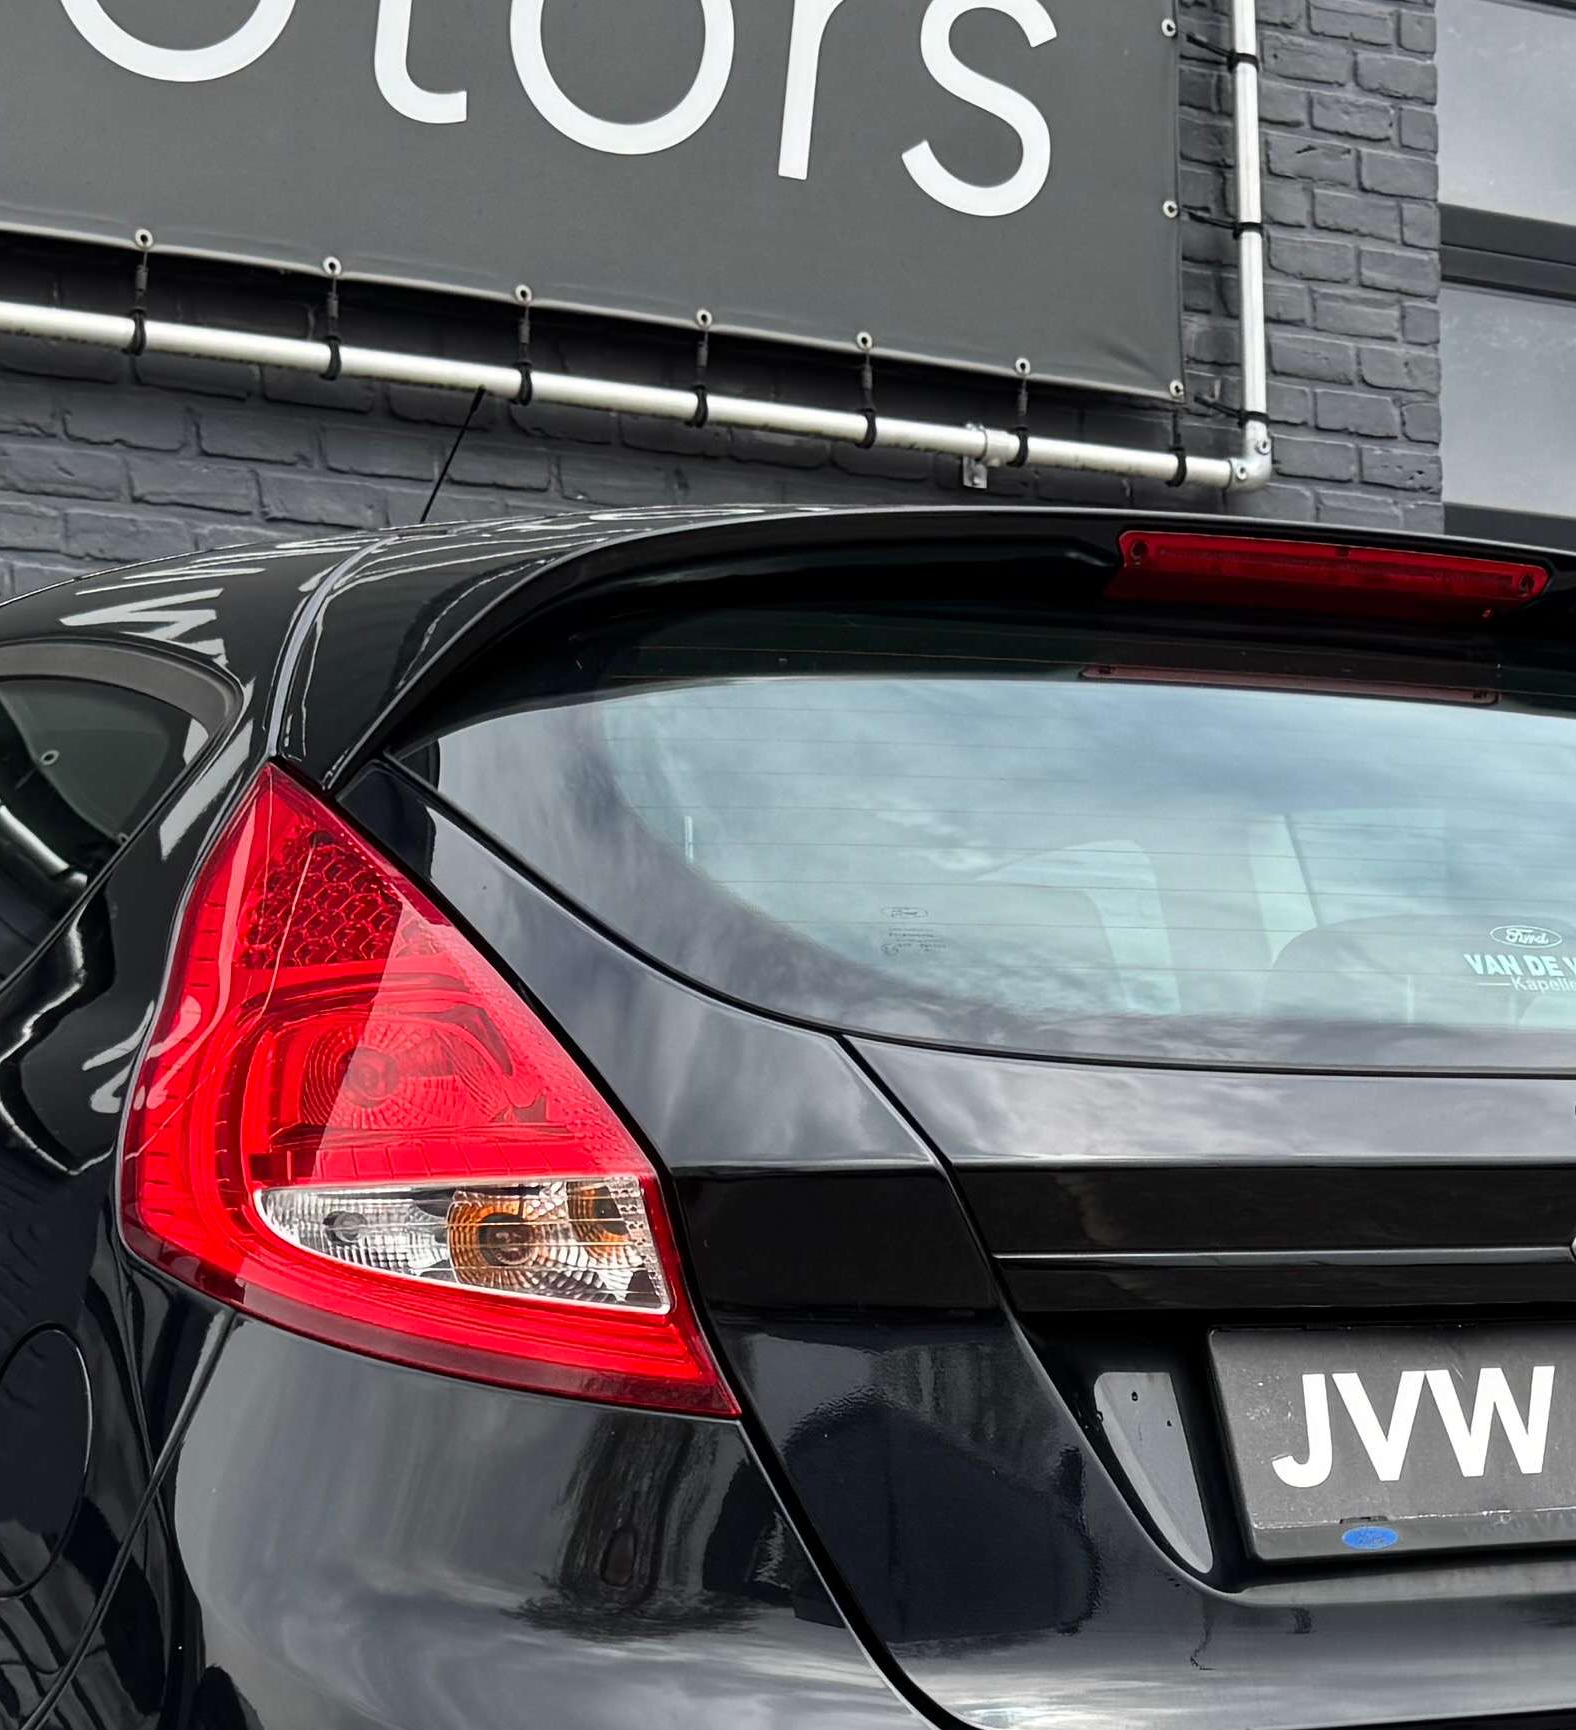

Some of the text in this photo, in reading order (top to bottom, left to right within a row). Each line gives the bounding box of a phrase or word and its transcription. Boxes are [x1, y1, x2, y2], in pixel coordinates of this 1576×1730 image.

[1505, 928, 1550, 946] Ford
[1464, 954, 1524, 976] VAN
[1523, 955, 1564, 977] DE
[1272, 1365, 1555, 1488] JVW
